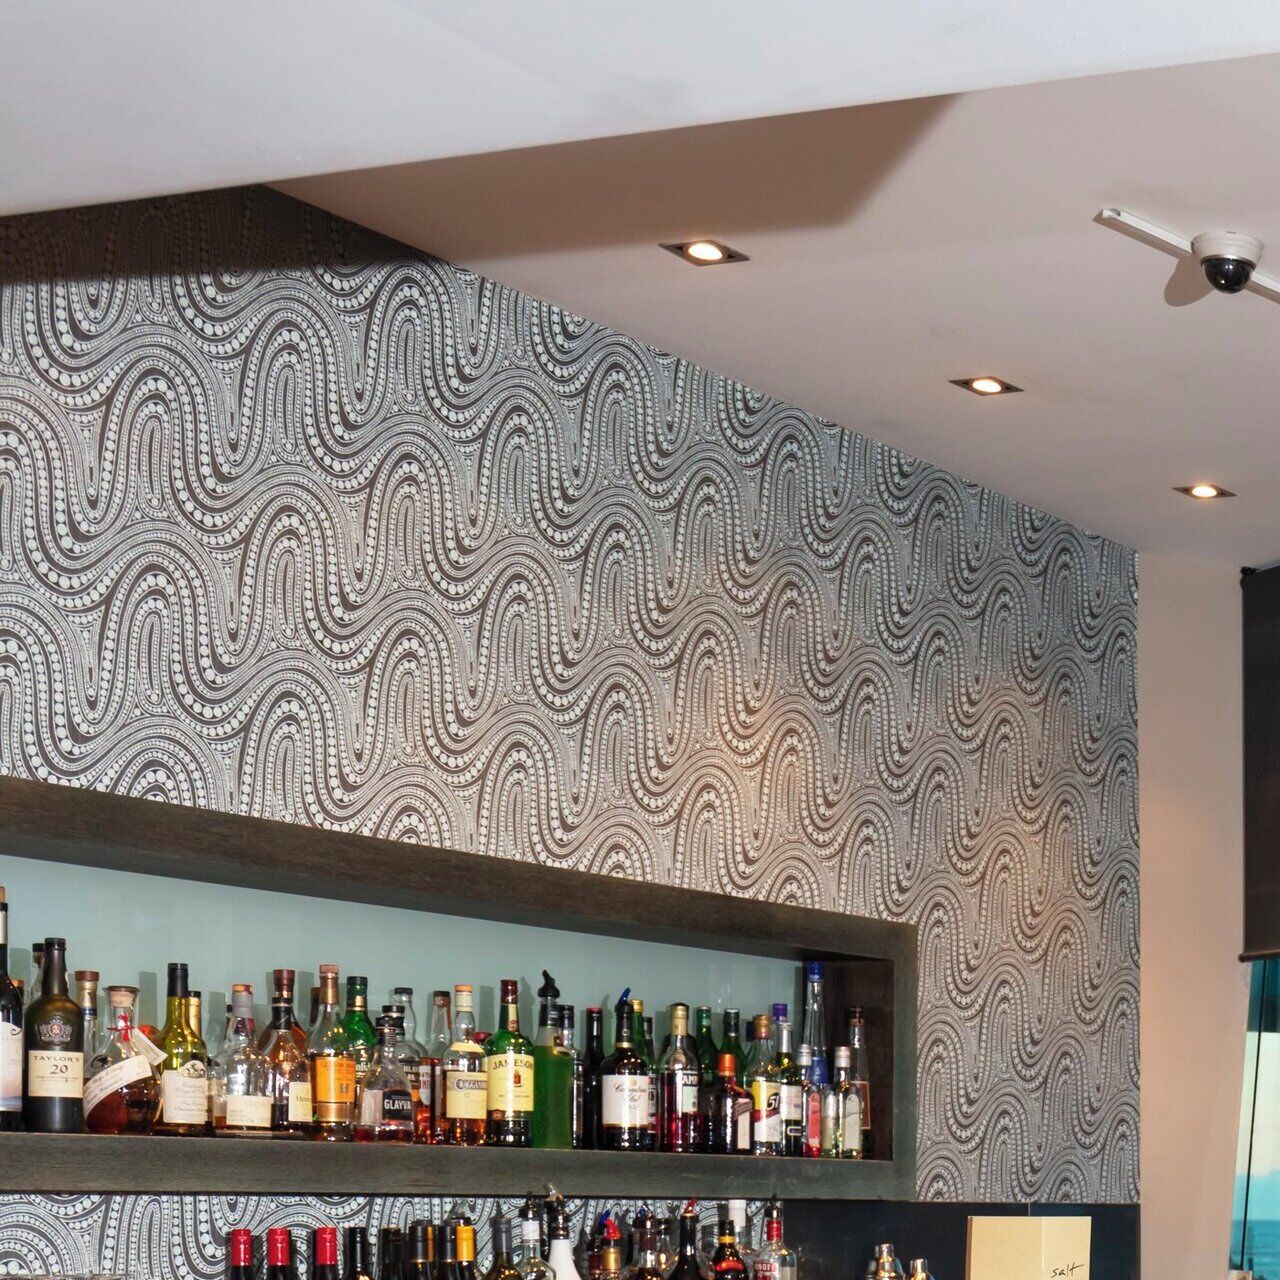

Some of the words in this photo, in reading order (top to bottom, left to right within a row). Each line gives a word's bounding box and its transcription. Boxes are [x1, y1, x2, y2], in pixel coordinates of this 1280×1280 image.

[50, 1064, 69, 1074] 20
[384, 1099, 412, 1111] GLAYVA
[767, 1096, 780, 1110] 51
[1051, 1262, 1085, 1278] salt
